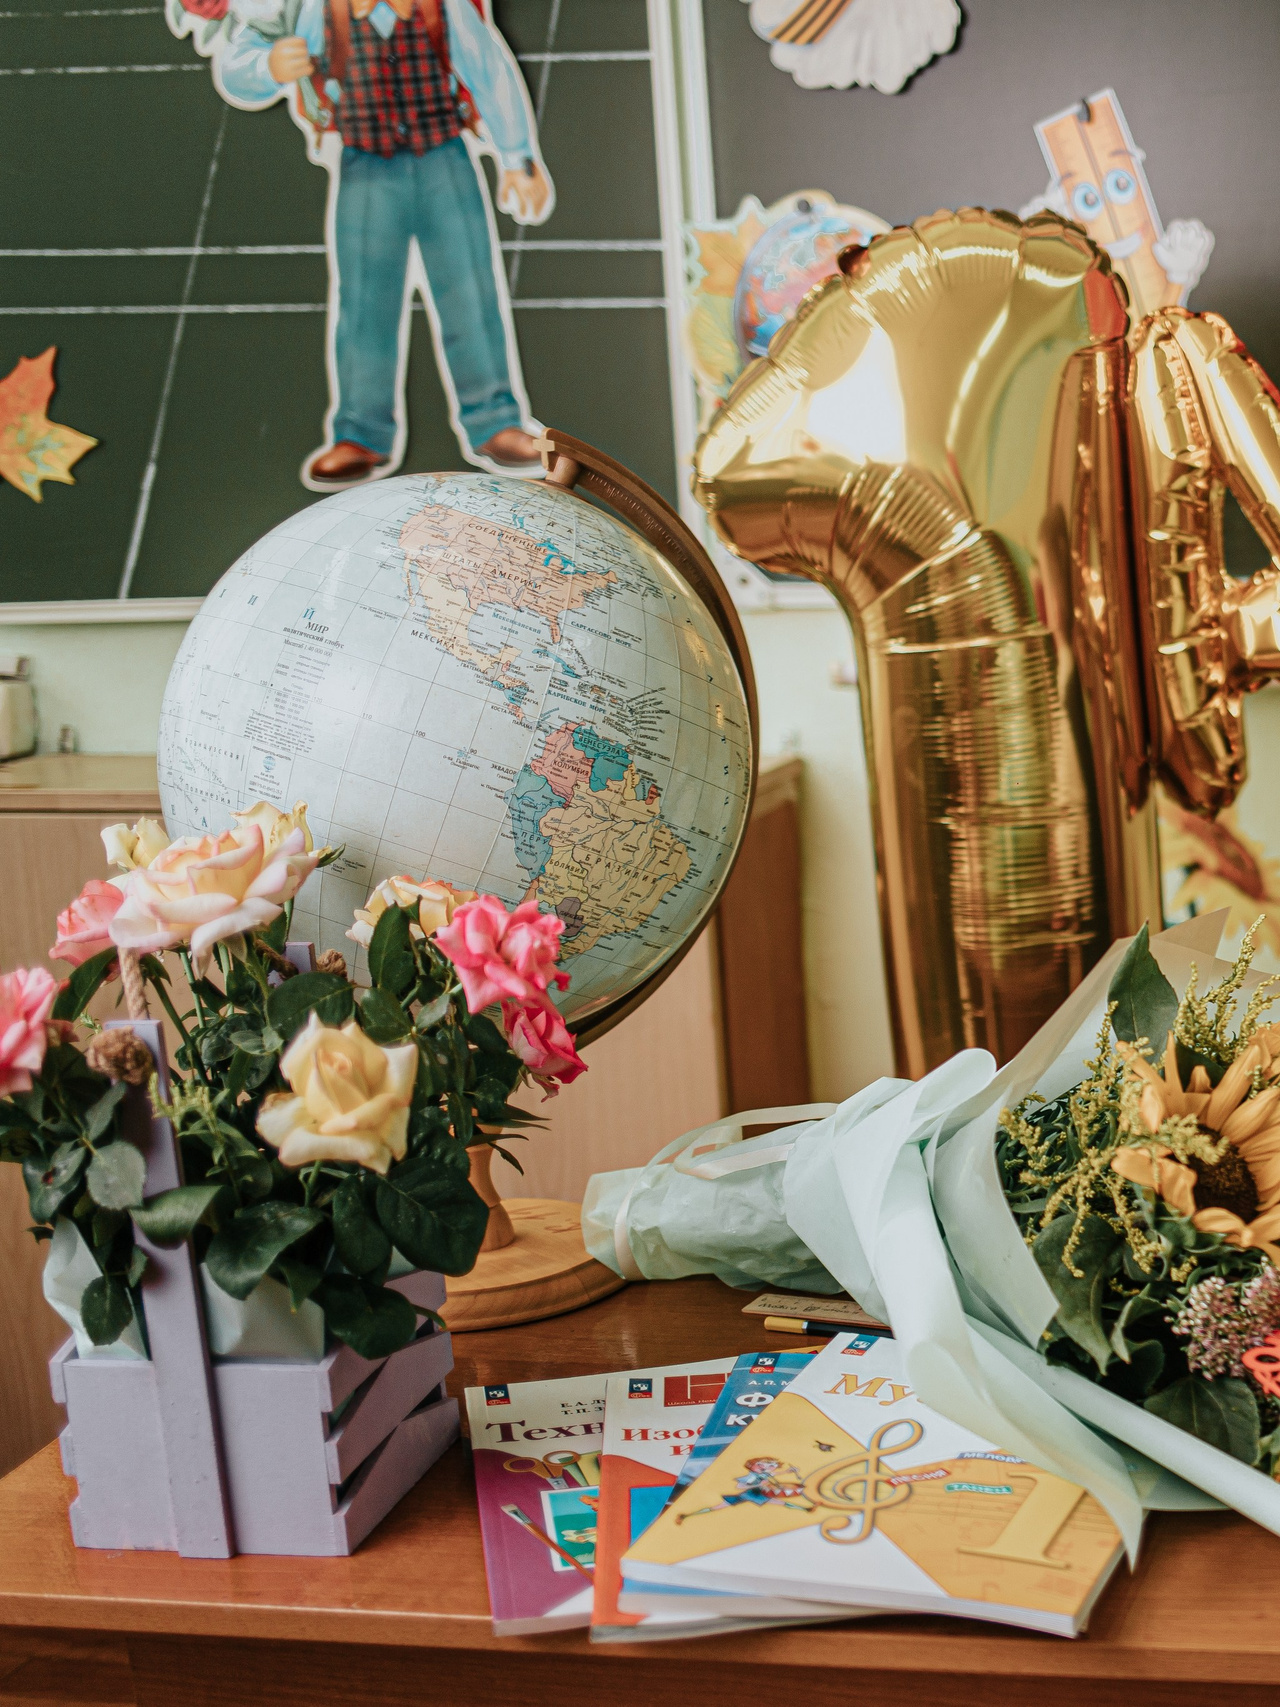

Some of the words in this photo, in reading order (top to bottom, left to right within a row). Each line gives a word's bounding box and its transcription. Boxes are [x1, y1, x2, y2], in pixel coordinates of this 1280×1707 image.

[490, 567, 542, 592] АМЕРИКИ
[305, 621, 330, 634] МИР
[410, 630, 456, 650] МЕКСИКА
[415, 729, 426, 738] 100
[553, 761, 590, 777] КОЛУМБИЯ
[521, 831, 549, 845] ПЕРУ
[549, 859, 586, 875] БОЛИВИЯ
[584, 854, 657, 885] БРАЗИЛИЯ
